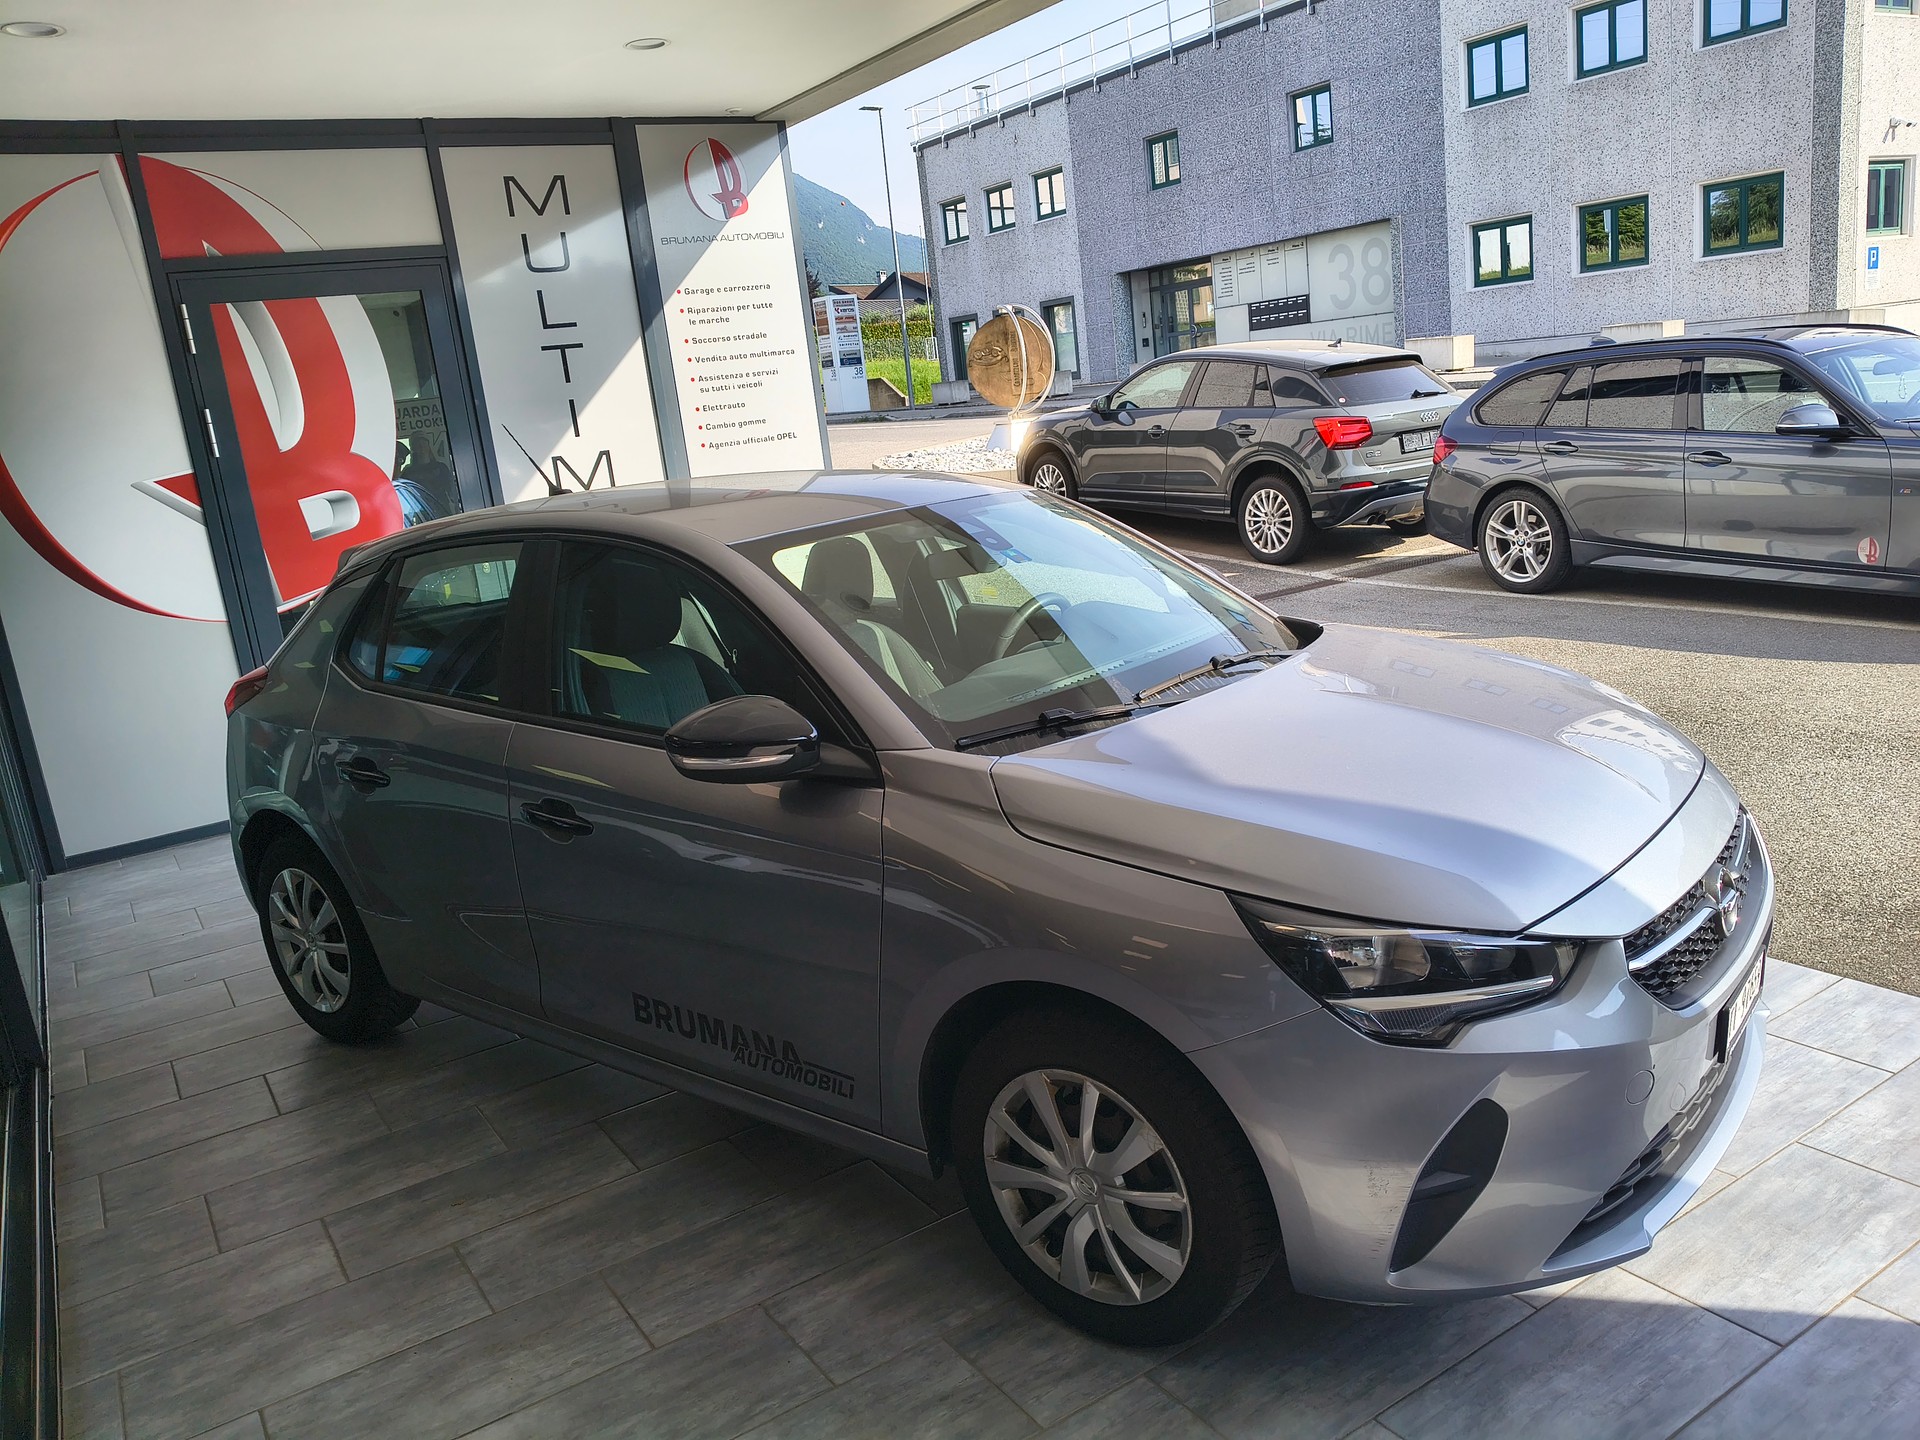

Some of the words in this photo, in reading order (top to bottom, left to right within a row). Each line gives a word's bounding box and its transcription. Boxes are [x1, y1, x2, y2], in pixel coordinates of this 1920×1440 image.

[660, 234, 719, 245] BRUMANA
[720, 231, 785, 242] AUTOMOBILI
[1328, 236, 1392, 310] 38
[684, 287, 715, 296] Garage
[723, 283, 771, 292] carrozzeria
[687, 305, 735, 315] Riparazioni
[736, 304, 750, 312] per
[752, 302, 774, 310] tutte
[698, 316, 730, 325] marche
[691, 335, 731, 345] Soccorso
[733, 332, 768, 341] stradale
[694, 355, 727, 364] Vendita
[729, 352, 748, 360] auto
[749, 349, 795, 359] multimarca
[698, 372, 744, 383] Assistenza
[752, 368, 779, 377] servizi
[854, 366, 864, 375] 38
[711, 384, 731, 392] tutti
[736, 380, 763, 389] veicoli
[702, 401, 746, 412] Elettrauto
[409, 417, 444, 430] LOOK!
[705, 421, 736, 431] Cambio
[737, 418, 767, 428] gomme
[708, 440, 741, 450] Agenzia
[742, 435, 775, 445] ufficiale
[776, 431, 798, 441] OPEL
[631, 991, 803, 1066] BRUMANA
[732, 1045, 856, 1100] AUTOMOBILI
